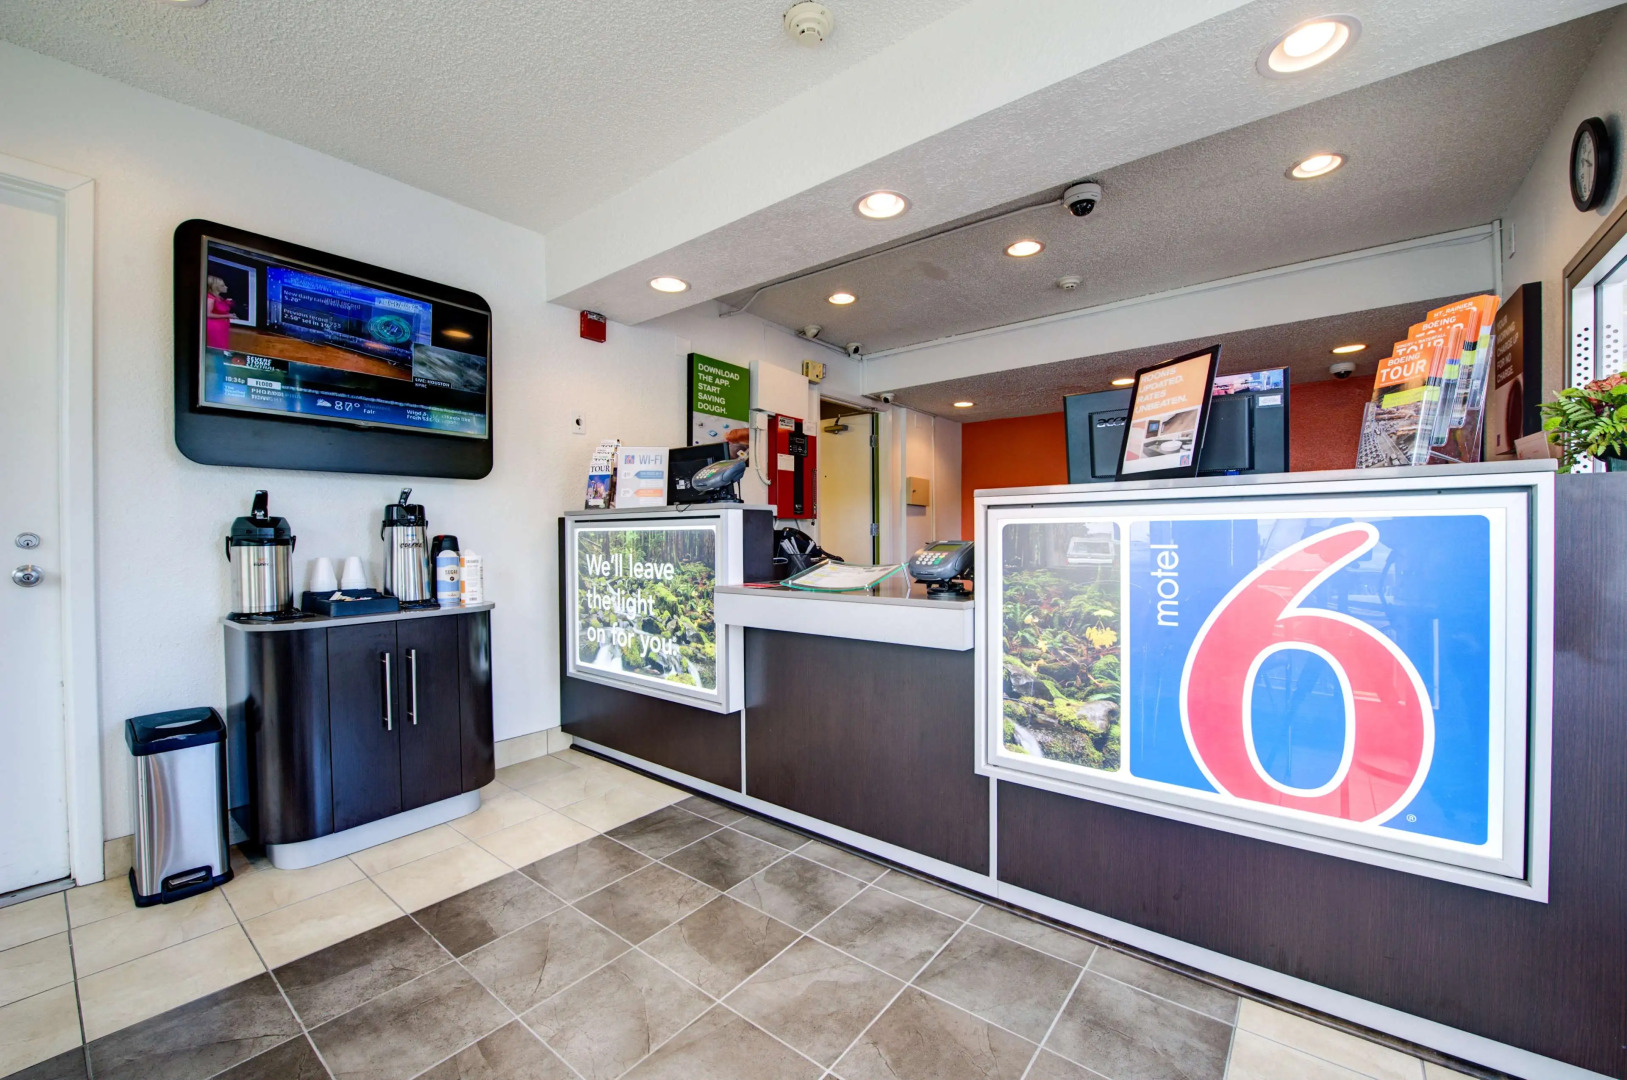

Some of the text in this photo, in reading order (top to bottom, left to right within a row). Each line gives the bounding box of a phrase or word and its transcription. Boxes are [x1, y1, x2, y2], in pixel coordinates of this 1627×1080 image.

[1445, 301, 1474, 314] RAINIER
[1422, 316, 1457, 331] BOEING
[1387, 352, 1420, 366] BOEING
[698, 363, 740, 381] DOWNLOAD
[1141, 367, 1177, 383] ROOMS
[1380, 359, 1427, 382] TOUR
[427, 379, 450, 388] HOUSTON
[697, 372, 731, 388] THE APP.
[698, 382, 721, 394] START
[697, 392, 726, 405] SAVING
[1137, 389, 1167, 403] RATES
[697, 401, 728, 415] DOUGH.
[638, 454, 663, 465] WI-FI
[591, 465, 611, 473] TOUR
[586, 553, 675, 581] We'll leave
[1150, 544, 1179, 627] motel
[586, 585, 655, 620] the light
[587, 626, 606, 643] on
[610, 622, 635, 648] for
[1179, 522, 1435, 828] 6
